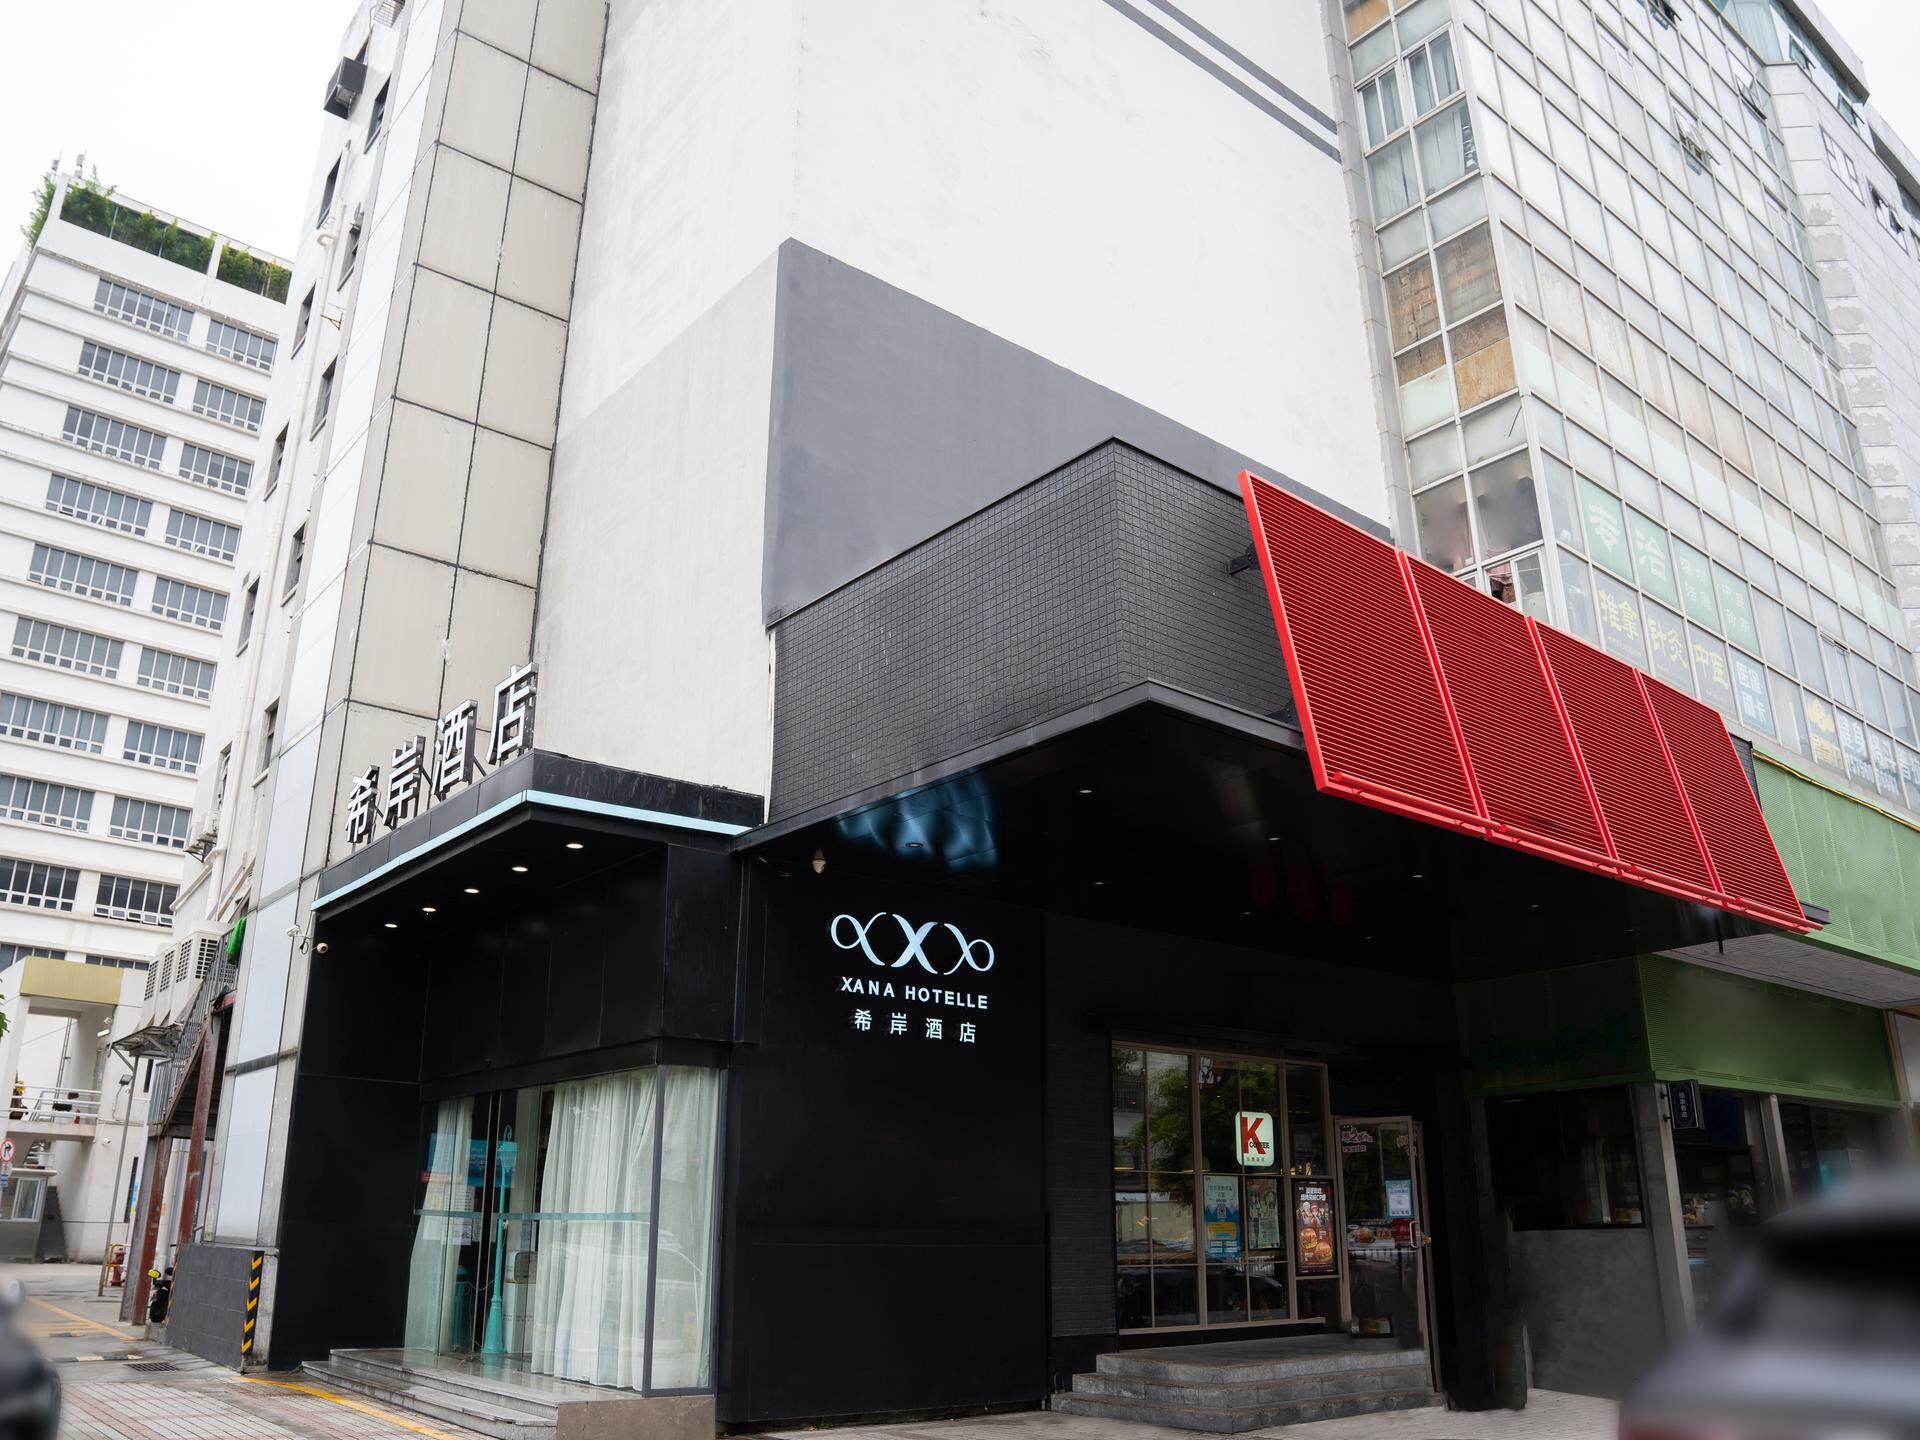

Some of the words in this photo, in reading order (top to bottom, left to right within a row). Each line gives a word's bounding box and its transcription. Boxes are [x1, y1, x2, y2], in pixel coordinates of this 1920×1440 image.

[345, 662, 539, 844] 希岸酒店
[841, 976, 895, 998] XANA
[905, 985, 988, 1010] HOTELLE
[854, 1008, 976, 1044] 希岸酒店
[1242, 1117, 1266, 1155] K
